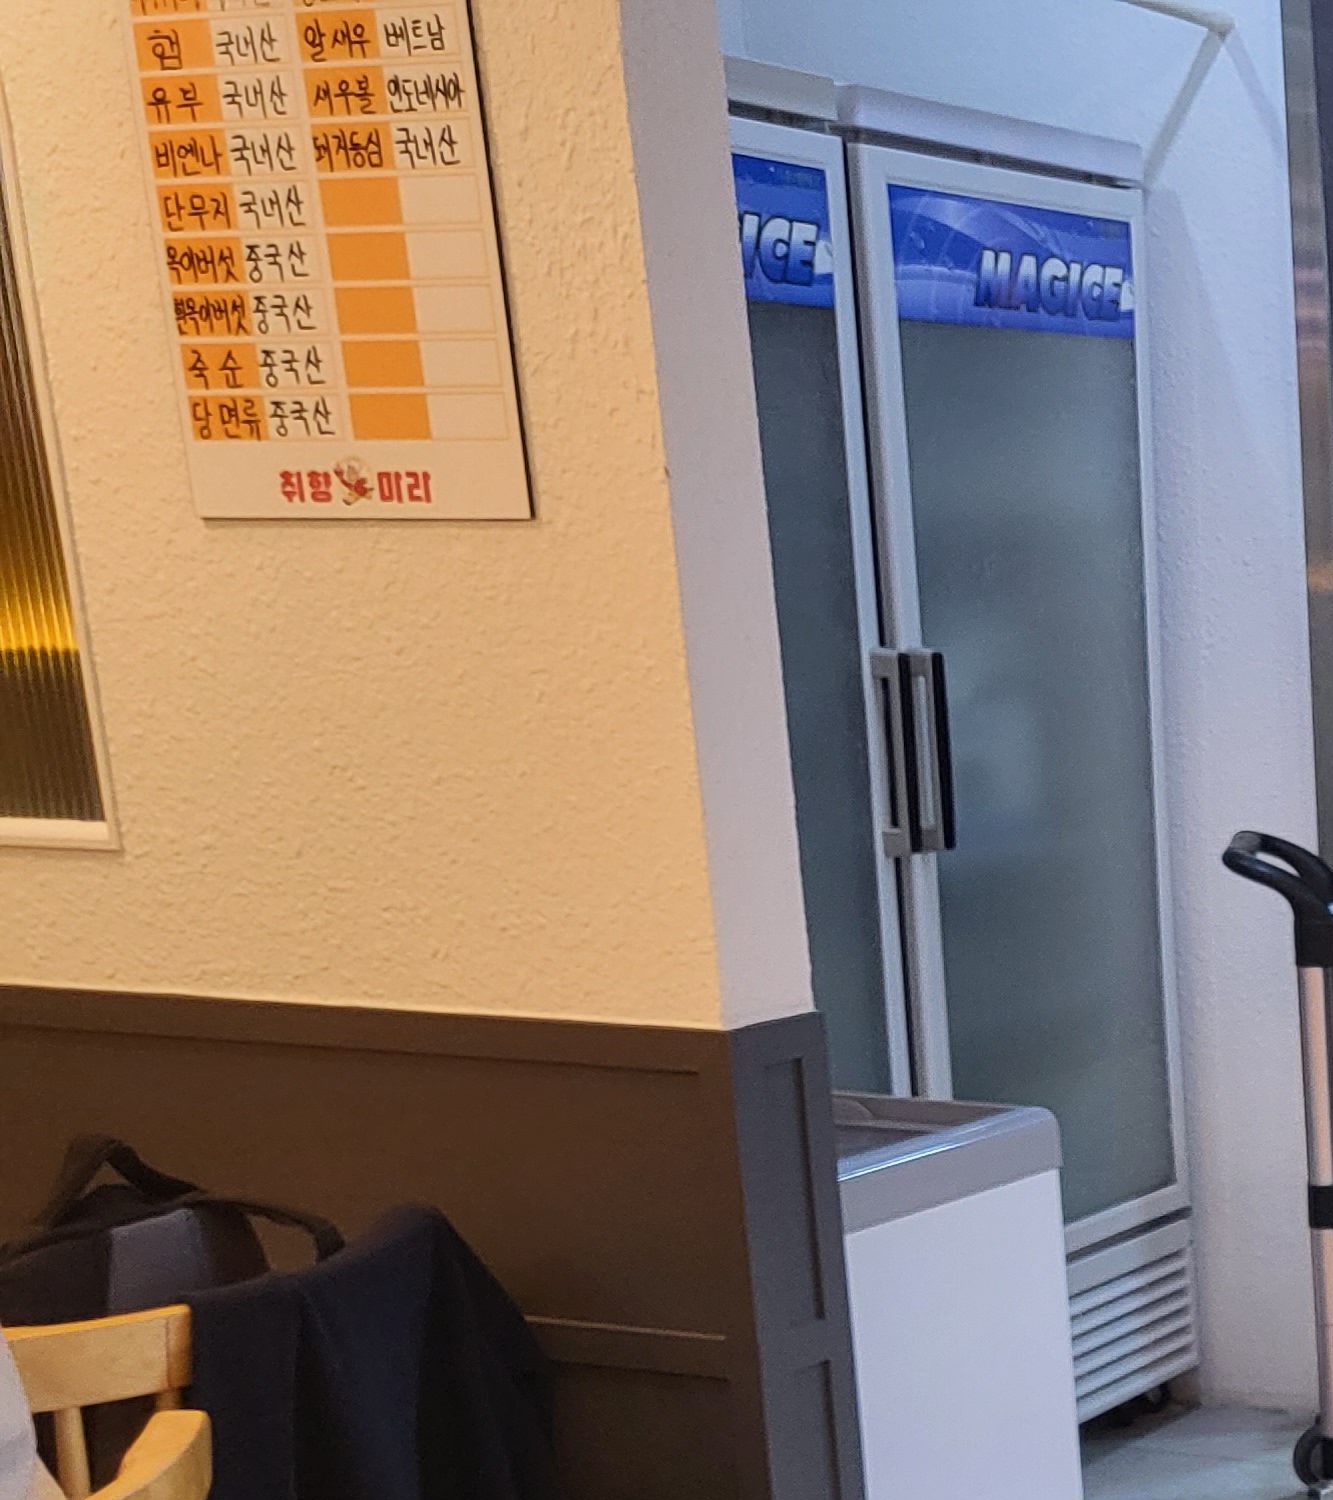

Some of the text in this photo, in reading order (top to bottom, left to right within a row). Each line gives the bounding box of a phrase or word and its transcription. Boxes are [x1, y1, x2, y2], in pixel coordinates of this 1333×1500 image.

[215, 21, 281, 66] 국내산
[384, 13, 445, 57] 베트남
[222, 75, 288, 119] 국내산
[314, 75, 377, 116] 새우볼
[387, 72, 465, 113] 인도네시아
[154, 135, 222, 178] 비엔나
[230, 132, 296, 176] 국내산
[312, 128, 383, 173] 돼지등심
[395, 124, 461, 169] 국내산
[163, 192, 231, 232] 단무지
[239, 184, 306, 229] 국내산
[245, 241, 310, 283] 중국산
[739, 210, 818, 287] ICE
[252, 294, 317, 334] 중국산
[259, 345, 326, 388] 중국산
[269, 396, 335, 437] 중국산
[280, 470, 333, 503] 취향
